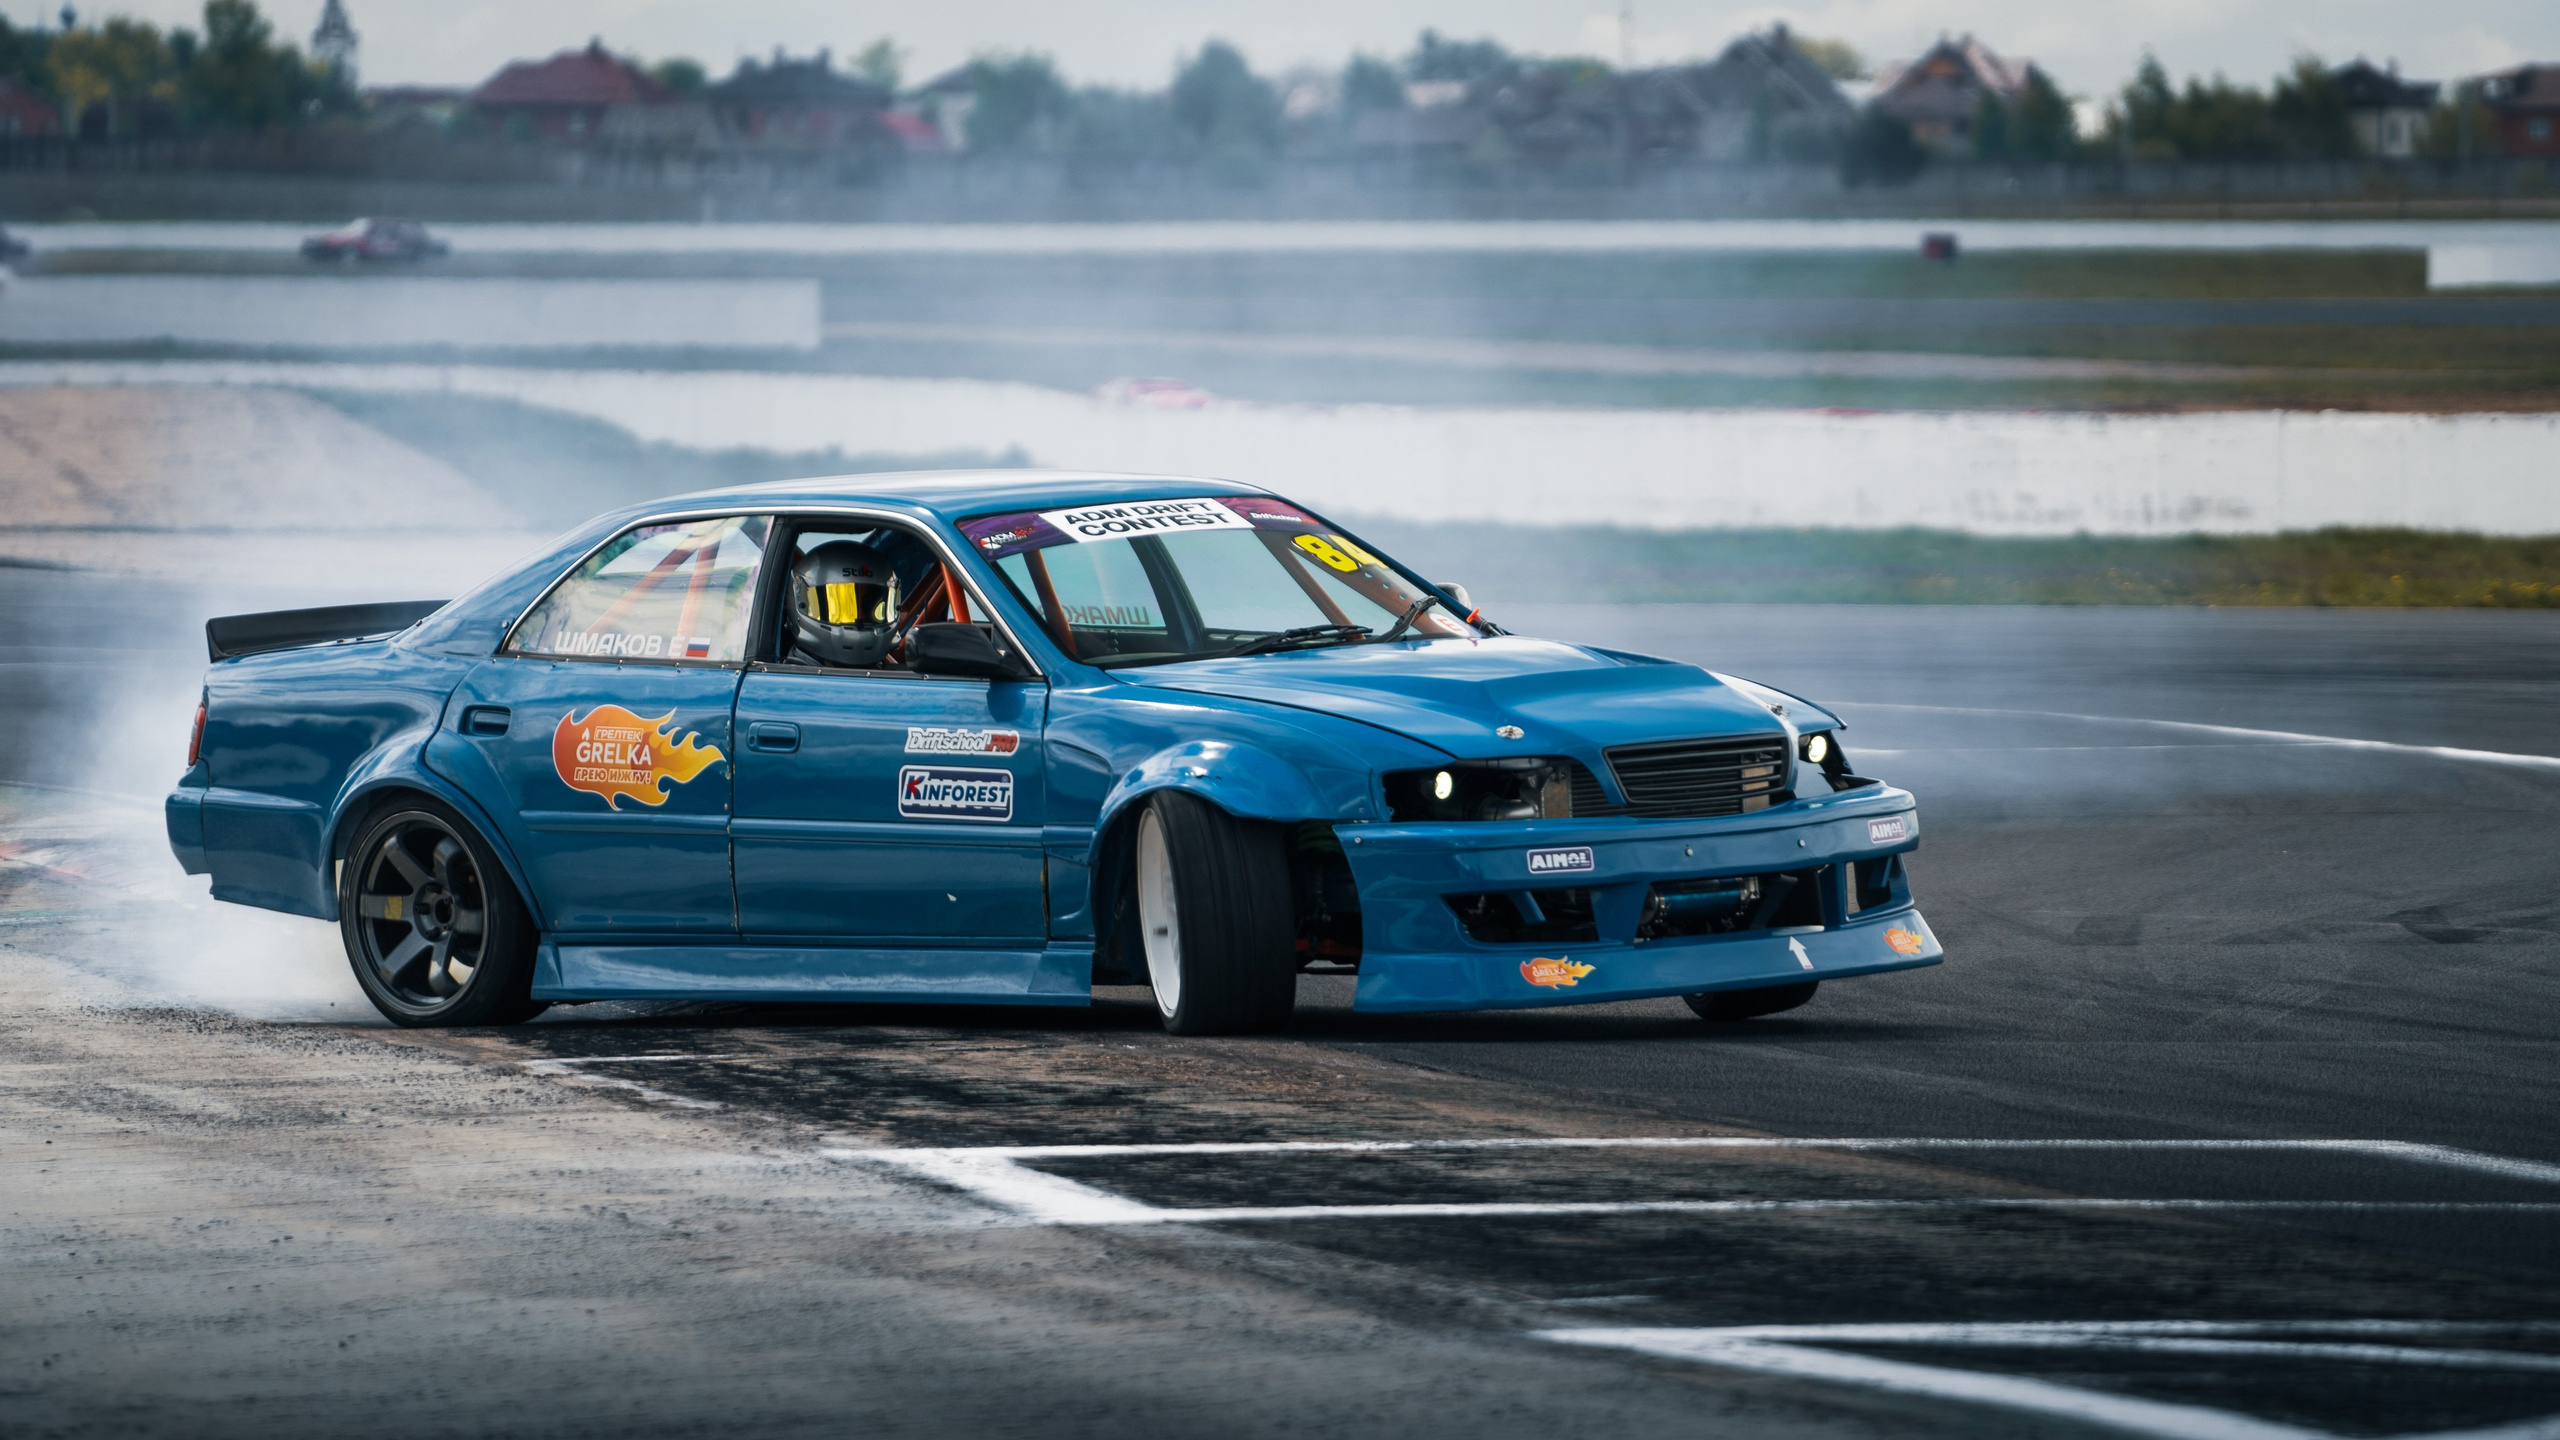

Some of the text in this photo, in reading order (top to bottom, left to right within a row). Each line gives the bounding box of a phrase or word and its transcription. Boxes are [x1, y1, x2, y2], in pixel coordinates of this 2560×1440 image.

[1064, 502, 1213, 525] ADM DRIFT
[1078, 512, 1230, 536] CONTEST
[554, 631, 663, 656] ШМАКОВ
[576, 741, 652, 766] GRELKA
[574, 766, 652, 785] ГРЕЮ И ЖГУ!
[905, 775, 1010, 803] KINFOREST
[1531, 852, 1591, 869] AIMOL
